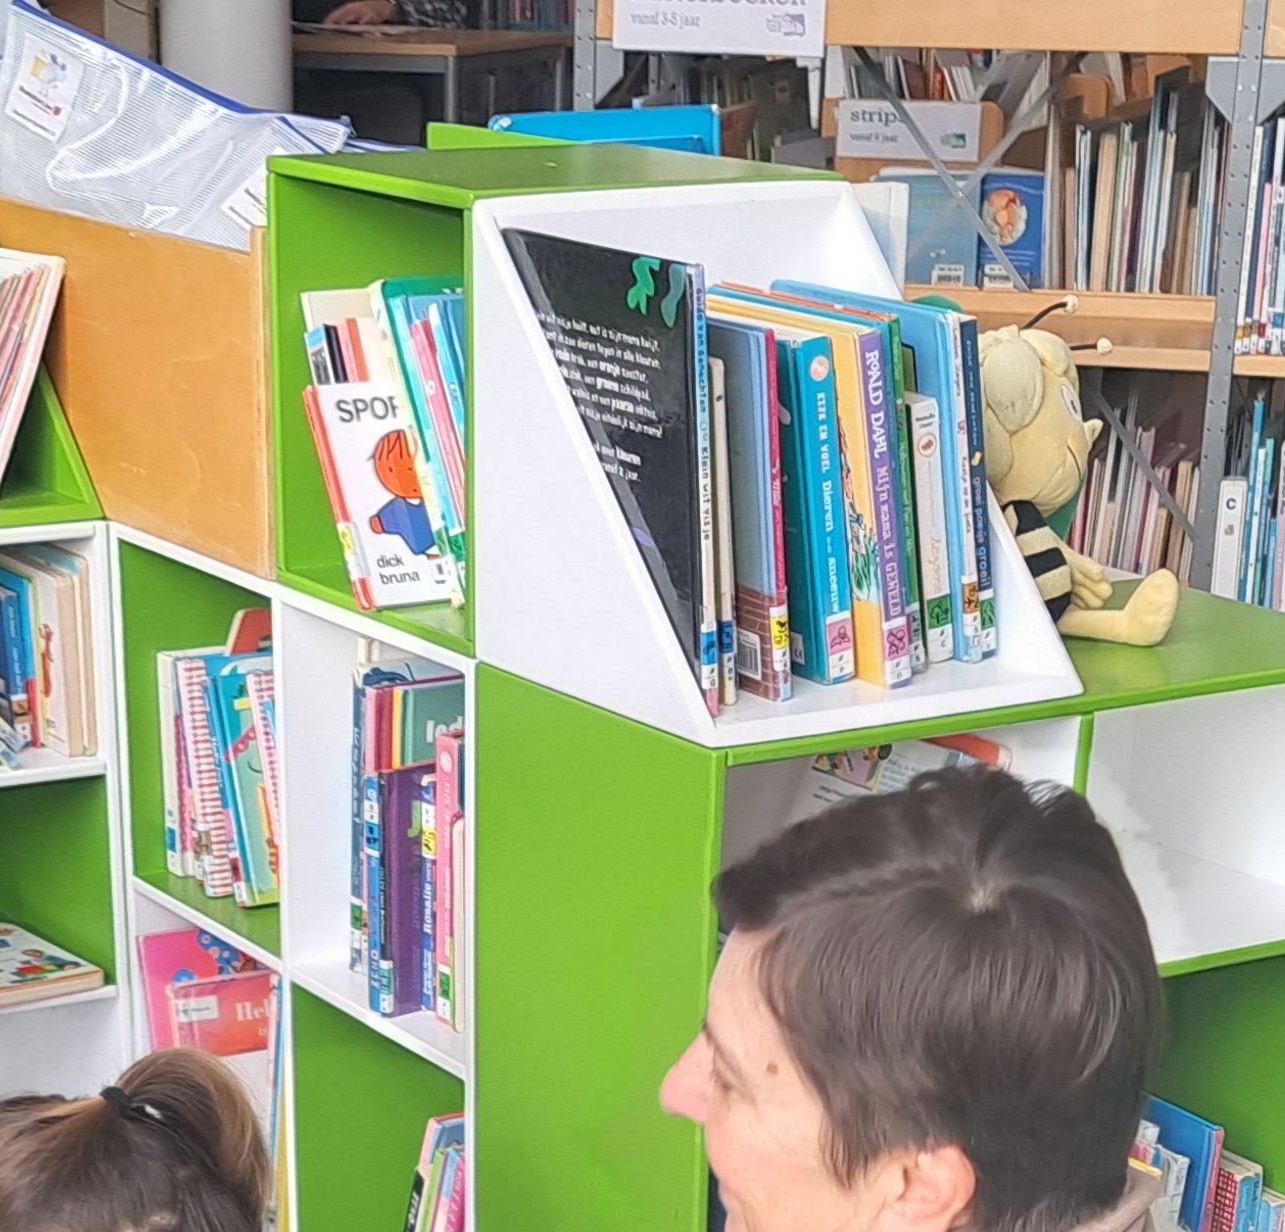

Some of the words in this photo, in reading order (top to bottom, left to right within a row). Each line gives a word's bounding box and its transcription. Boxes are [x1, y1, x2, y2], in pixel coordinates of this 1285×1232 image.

[631, 12, 659, 26] vanaf
[660, 11, 678, 26] 3-5
[679, 14, 701, 29] jaar
[850, 106, 905, 128] strip
[695, 288, 704, 321] Guido
[697, 349, 707, 414] Genechten
[865, 349, 884, 407] ROALD
[818, 425, 829, 441] EN
[870, 409, 888, 460] DAHL
[701, 445, 710, 480] Klein
[820, 444, 831, 475] VOEL
[702, 482, 711, 504] wit
[876, 465, 891, 503] Mijn
[821, 479, 835, 533] Dieren
[1225, 497, 1237, 510] C
[880, 504, 892, 542] mama
[376, 553, 405, 569] dick
[882, 542, 896, 560] is
[978, 545, 992, 587] groei!
[379, 567, 421, 585] bruna
[827, 556, 840, 613] sneeuw
